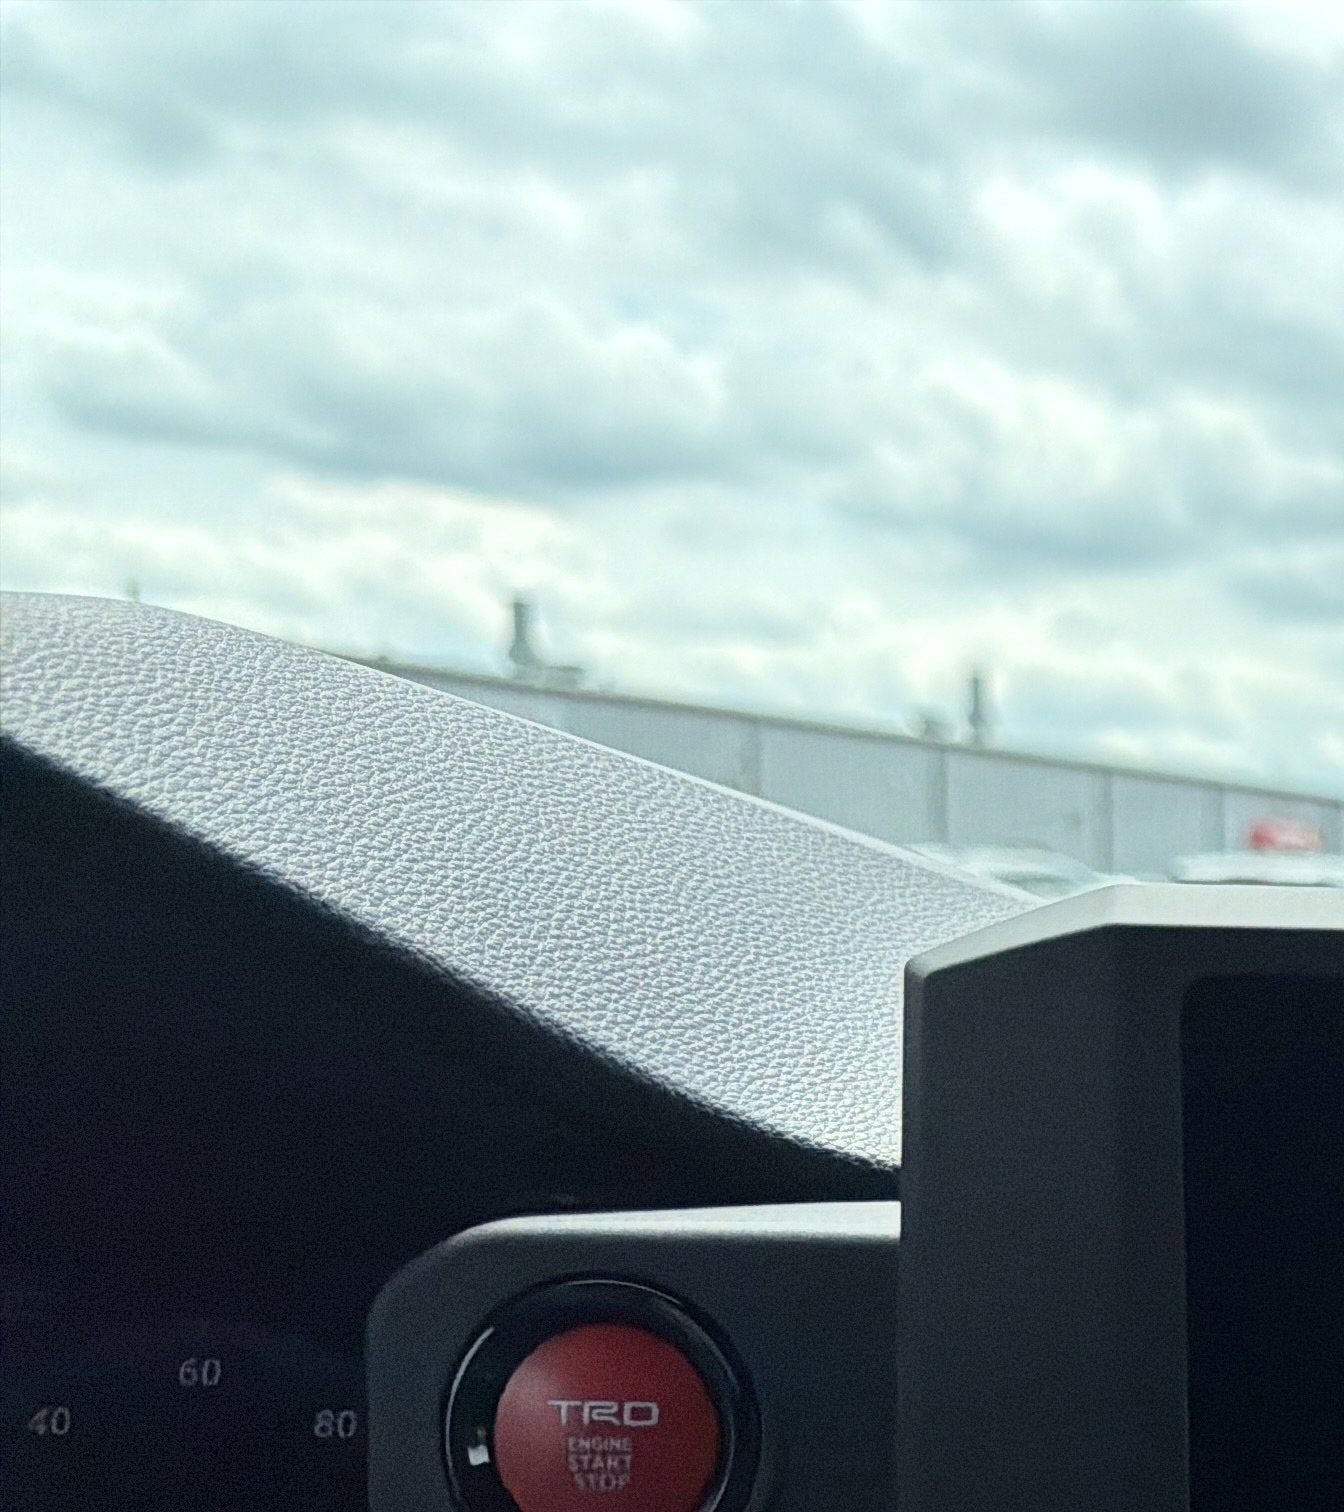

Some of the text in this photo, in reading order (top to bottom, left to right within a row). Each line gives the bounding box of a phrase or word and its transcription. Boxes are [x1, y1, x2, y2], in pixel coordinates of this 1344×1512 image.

[178, 1358, 222, 1387] 60
[28, 1407, 72, 1436] 40
[313, 1410, 358, 1439] 80
[547, 1400, 660, 1427] TRD
[568, 1437, 632, 1452] ENGINE
[569, 1454, 632, 1470] START
[574, 1473, 629, 1490] STOP
